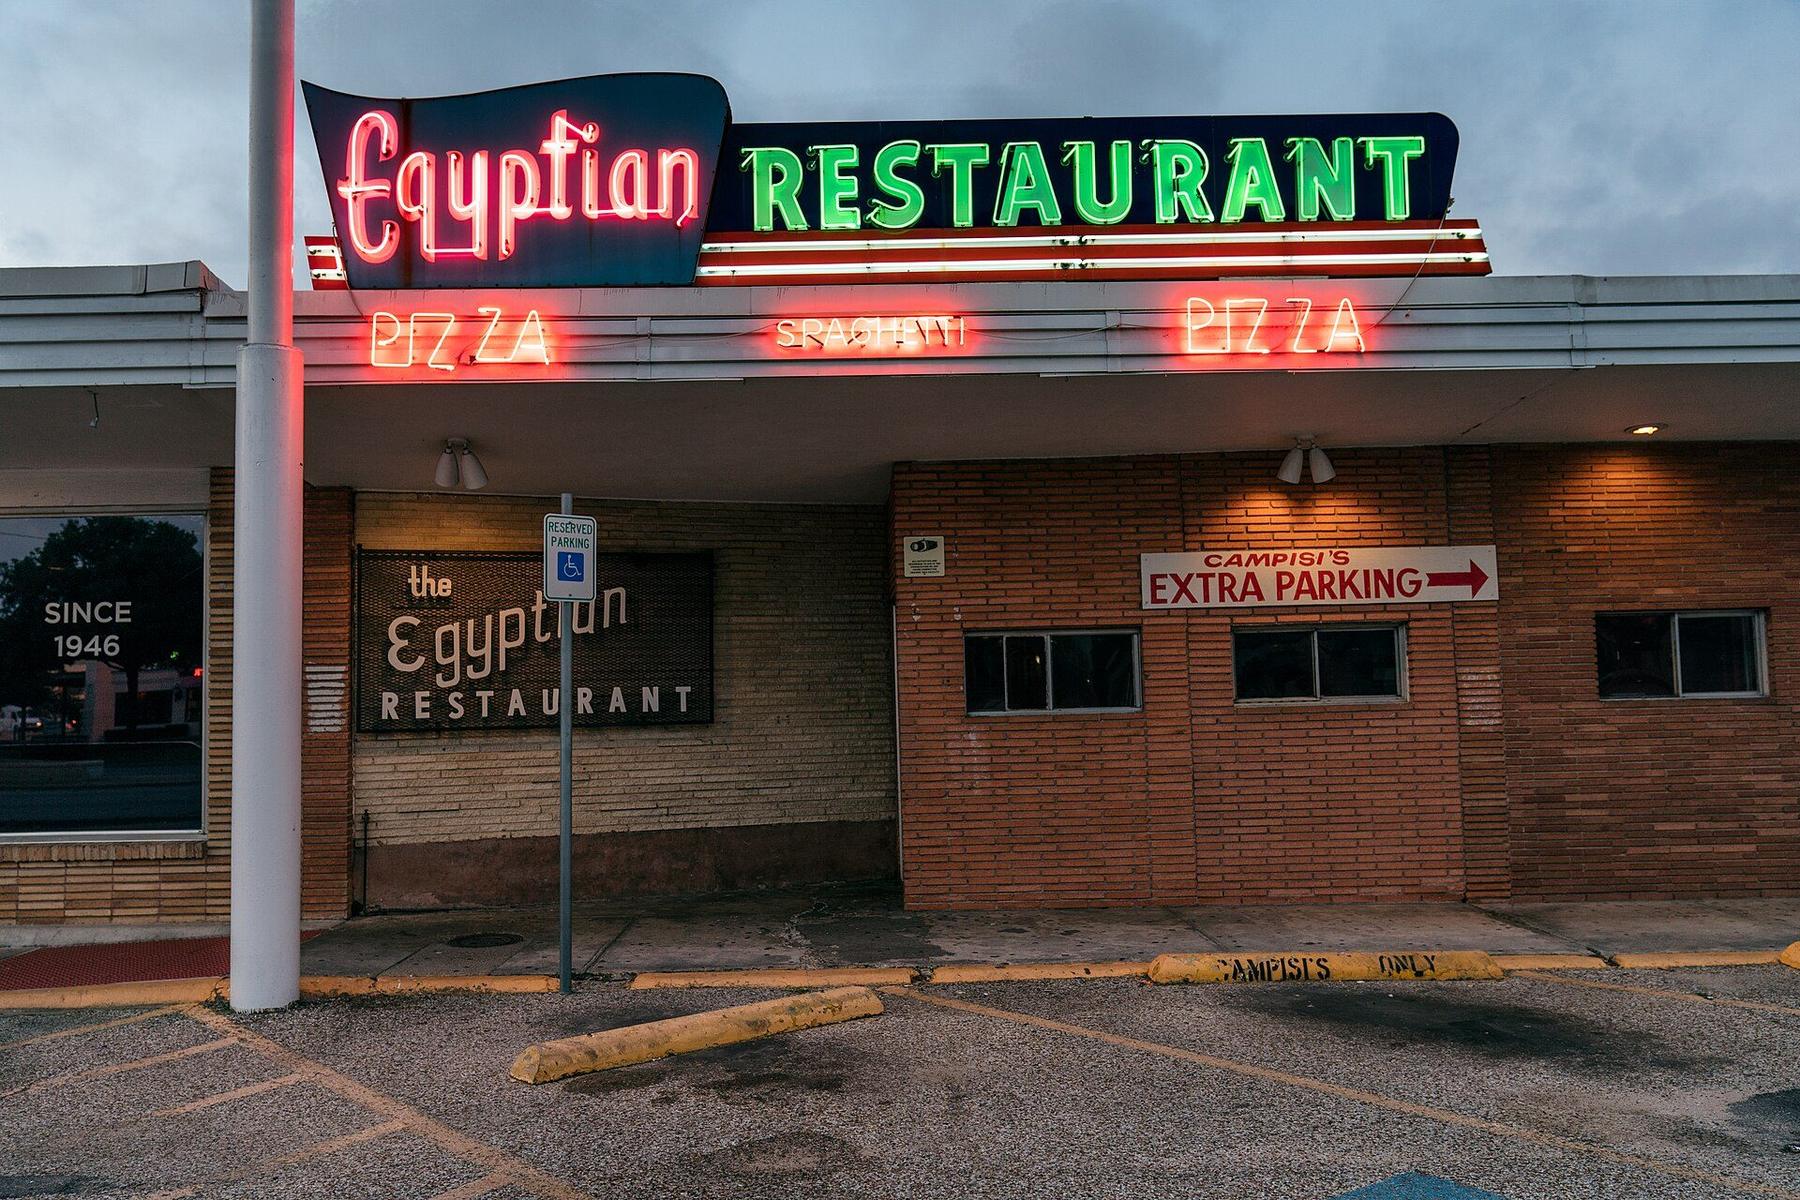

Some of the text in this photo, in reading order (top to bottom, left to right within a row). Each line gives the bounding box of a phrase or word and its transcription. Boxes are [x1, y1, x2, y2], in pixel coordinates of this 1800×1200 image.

[336, 108, 1426, 262] Egyptian RESTAURANT
[371, 307, 550, 372] PIZZA
[776, 315, 965, 348] SPAGHETTI
[1186, 297, 1366, 354] PIZZA
[548, 521, 593, 535] RESERVED
[551, 536, 590, 549] PARKING
[1204, 549, 1350, 568] CAMPISI'S
[407, 565, 452, 598] the
[1149, 566, 1423, 605] EXTRA PARKING
[44, 600, 132, 624] SINCE
[53, 634, 121, 658] 1946
[381, 685, 692, 720] RESTAURANT
